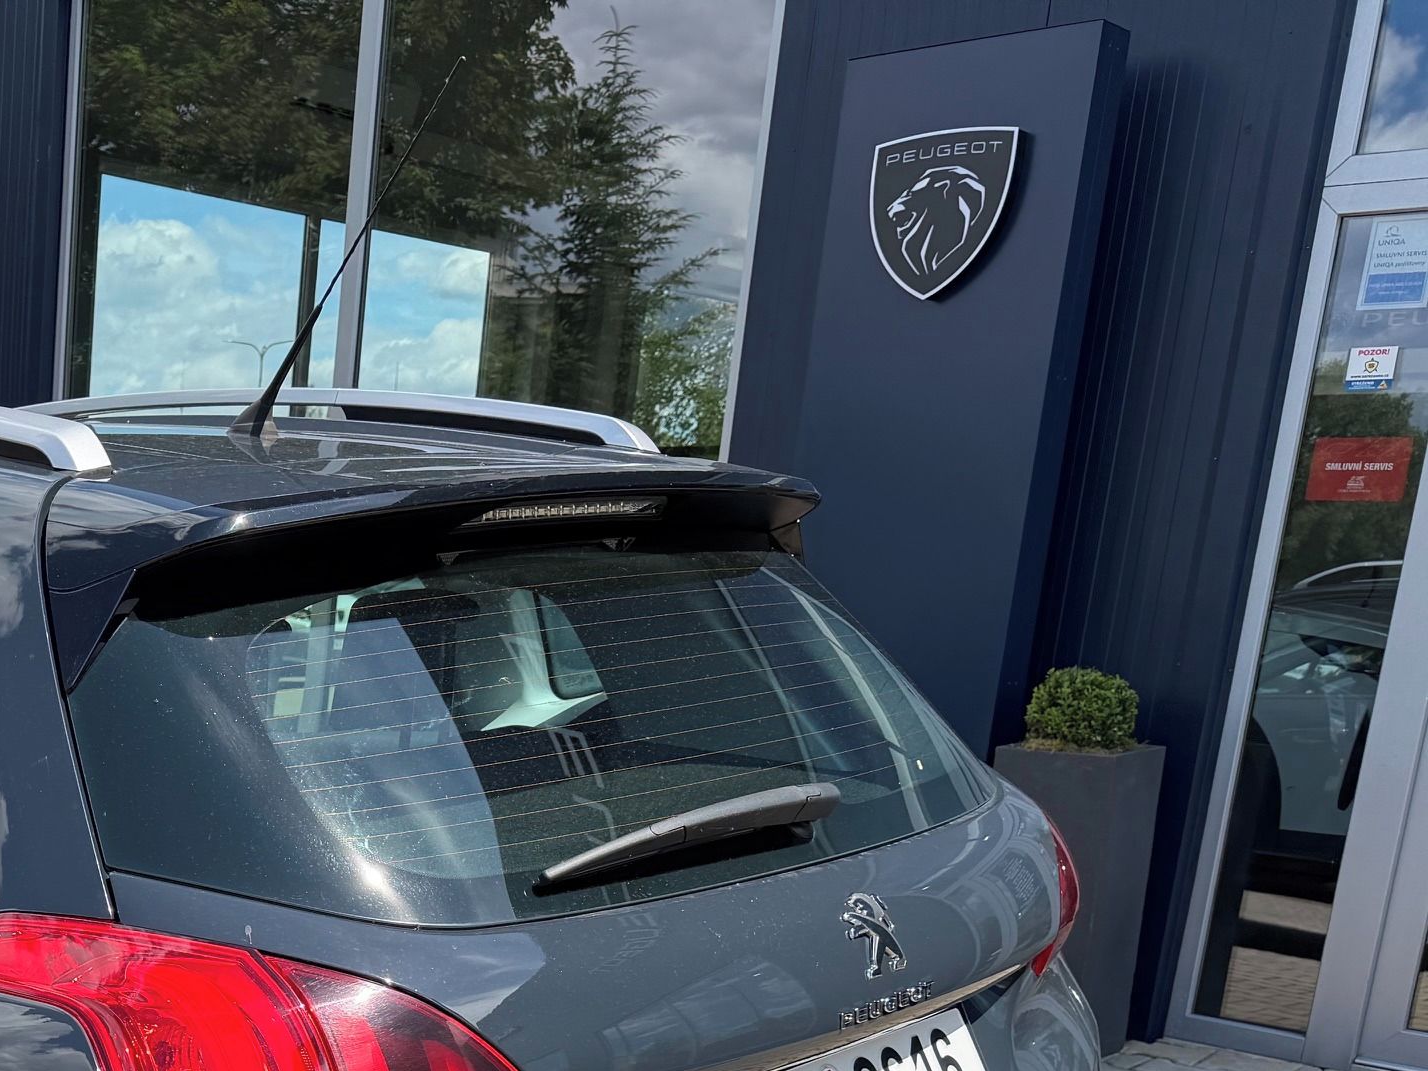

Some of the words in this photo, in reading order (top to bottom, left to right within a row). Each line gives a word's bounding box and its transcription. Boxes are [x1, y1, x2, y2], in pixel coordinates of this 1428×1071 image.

[886, 141, 1003, 167] PEUGEOT
[1377, 239, 1406, 247] UNIQA
[1324, 461, 1363, 471] SMLUVNÍ
[1363, 462, 1394, 471] SERVIS
[838, 980, 935, 1030] PEUGEOT
